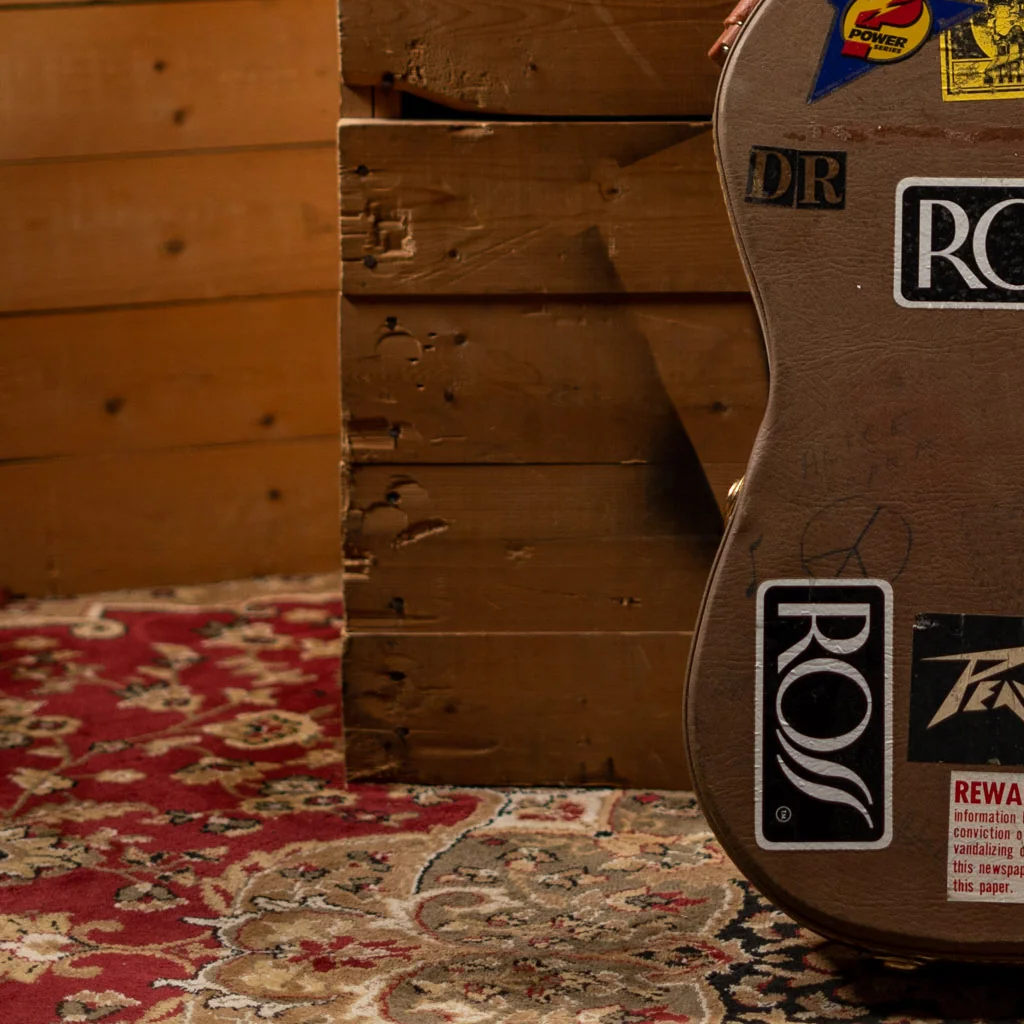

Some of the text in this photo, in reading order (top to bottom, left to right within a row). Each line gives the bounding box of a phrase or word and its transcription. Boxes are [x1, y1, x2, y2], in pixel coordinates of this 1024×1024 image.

[848, 28, 908, 48] POWER
[873, 44, 902, 53] SERIES
[776, 603, 874, 829] ROSS
[954, 809, 1016, 824] information
[953, 825, 1010, 840] conviction
[953, 842, 1013, 860] vandalizing
[953, 860, 973, 874] this
[953, 879, 1014, 896] this paper.
